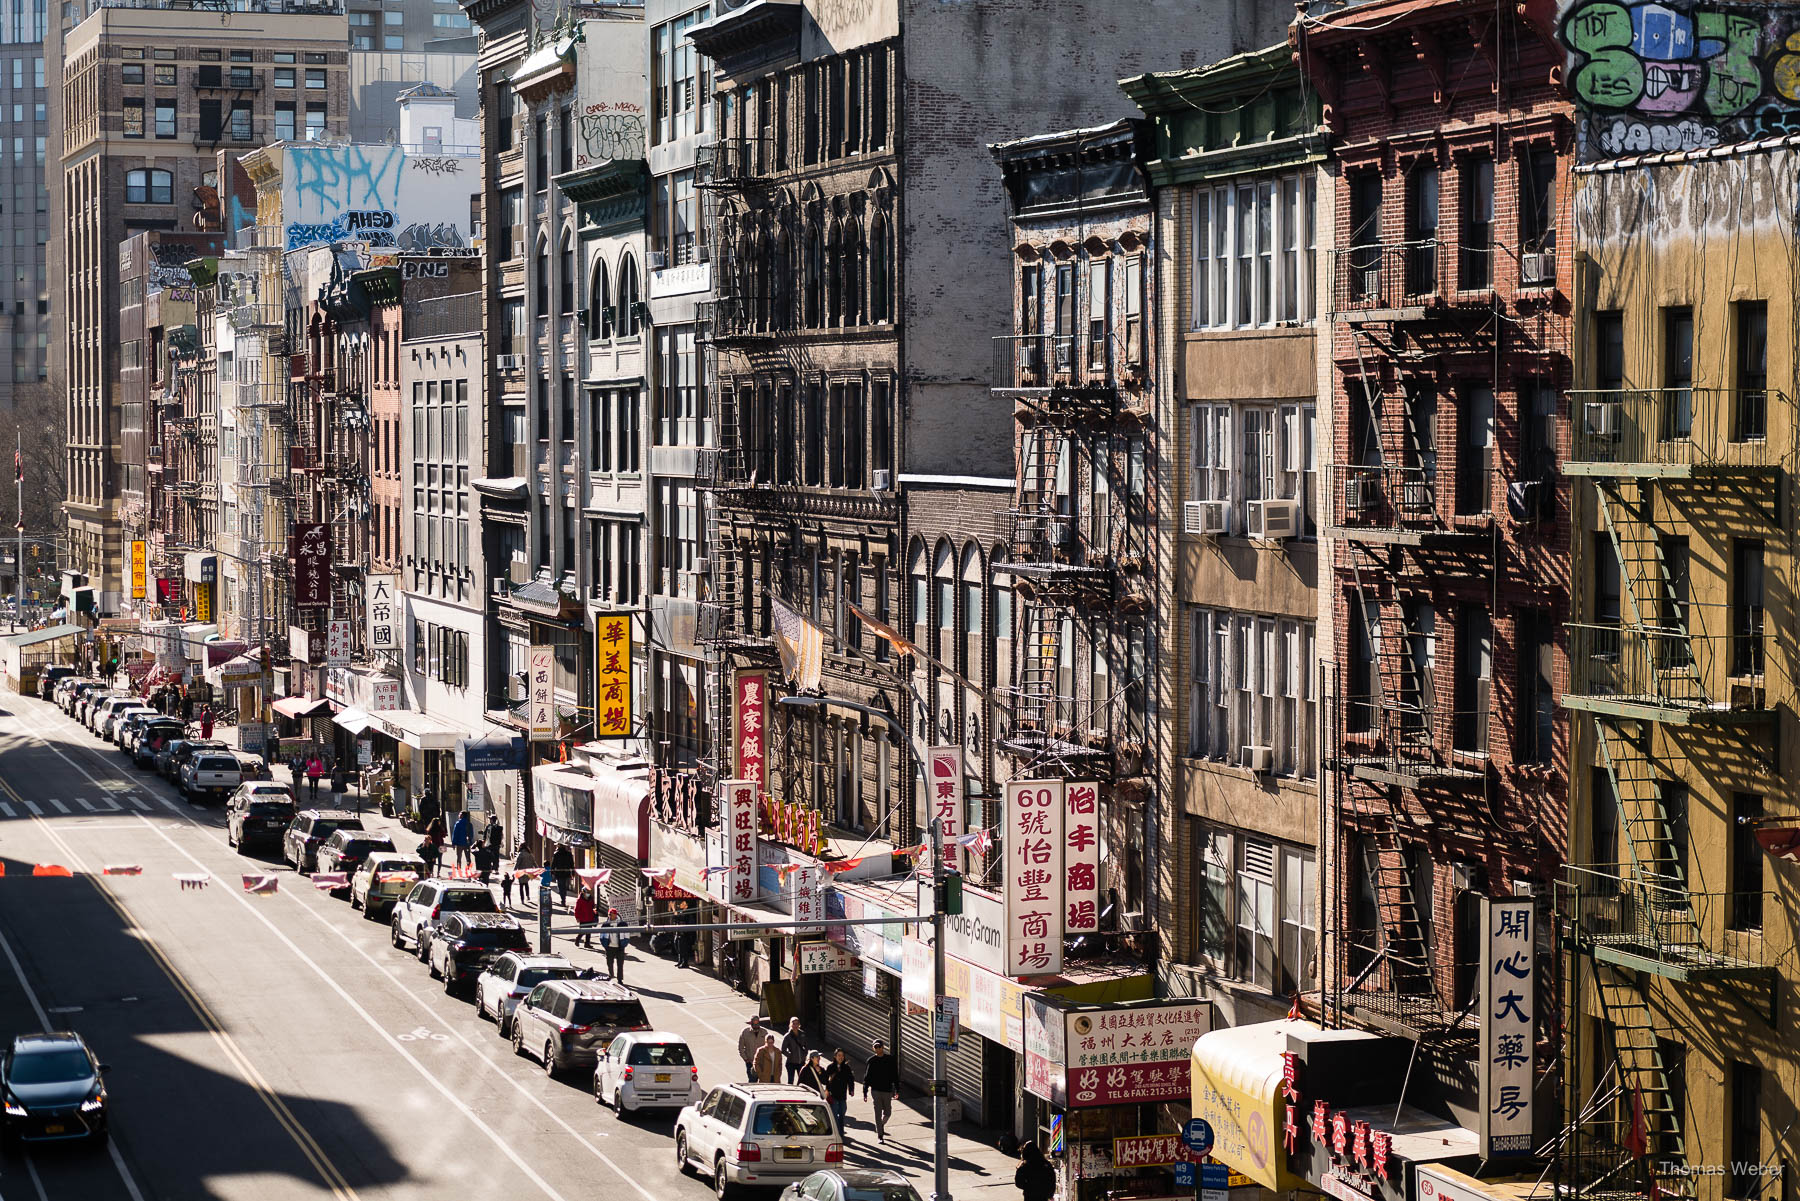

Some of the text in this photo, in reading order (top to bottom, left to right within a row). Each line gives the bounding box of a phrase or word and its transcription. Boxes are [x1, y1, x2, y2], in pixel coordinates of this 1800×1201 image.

[403, 260, 448, 279] PNG
[300, 542, 327, 556] 永昌
[372, 580, 391, 645] 大帝國
[602, 620, 628, 732] 華美商場
[741, 681, 763, 785] 農家飯莊
[734, 788, 753, 899] 興旺旺商場
[1491, 909, 1531, 1121] 開心大藥房
[1080, 1029, 1175, 1051] 福州大花店
[1108, 1091, 1122, 1099] TEL
[1124, 1090, 1130, 1098] &
[1131, 1089, 1149, 1097] FAX:
[1150, 1086, 1191, 1096] 212-513-1
[1176, 1163, 1187, 1173] M9
[1176, 1175, 1192, 1185] M22
